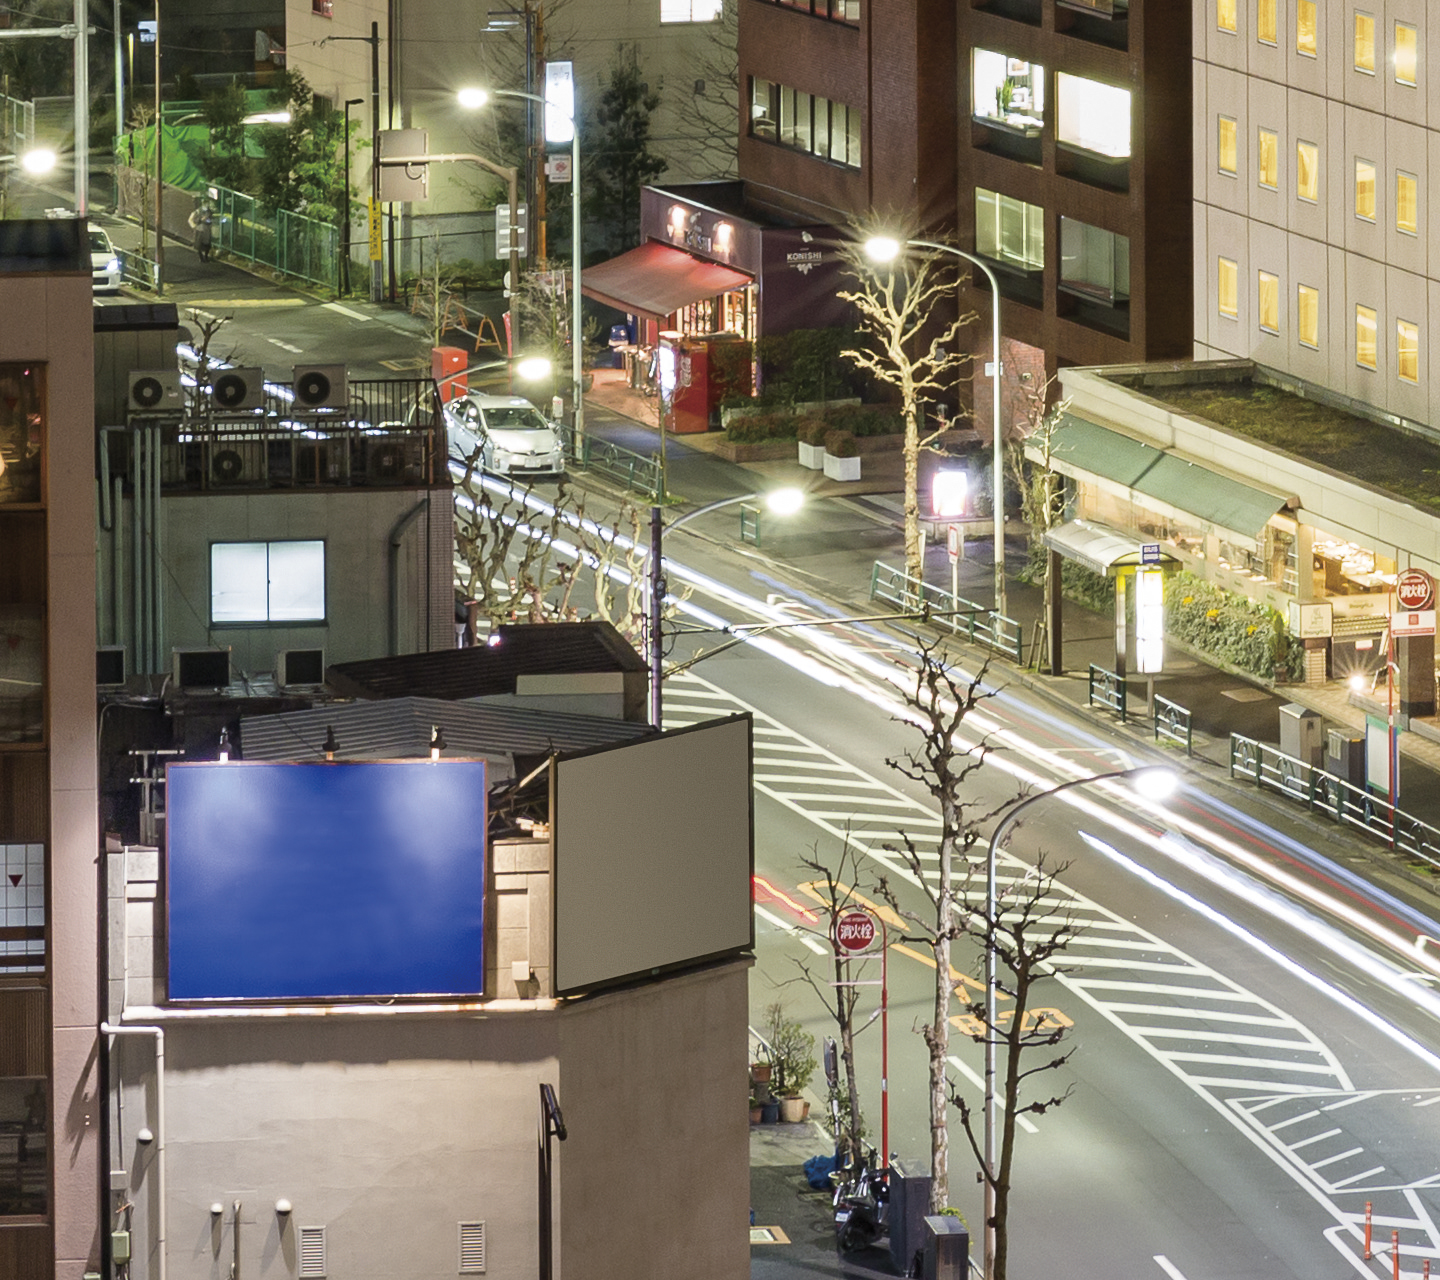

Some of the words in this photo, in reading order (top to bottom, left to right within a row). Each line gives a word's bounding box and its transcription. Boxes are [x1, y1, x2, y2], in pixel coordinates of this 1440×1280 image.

[786, 251, 822, 261] KONISHI
[1400, 583, 1427, 598] 消火栓
[840, 923, 873, 940] 消火栓
